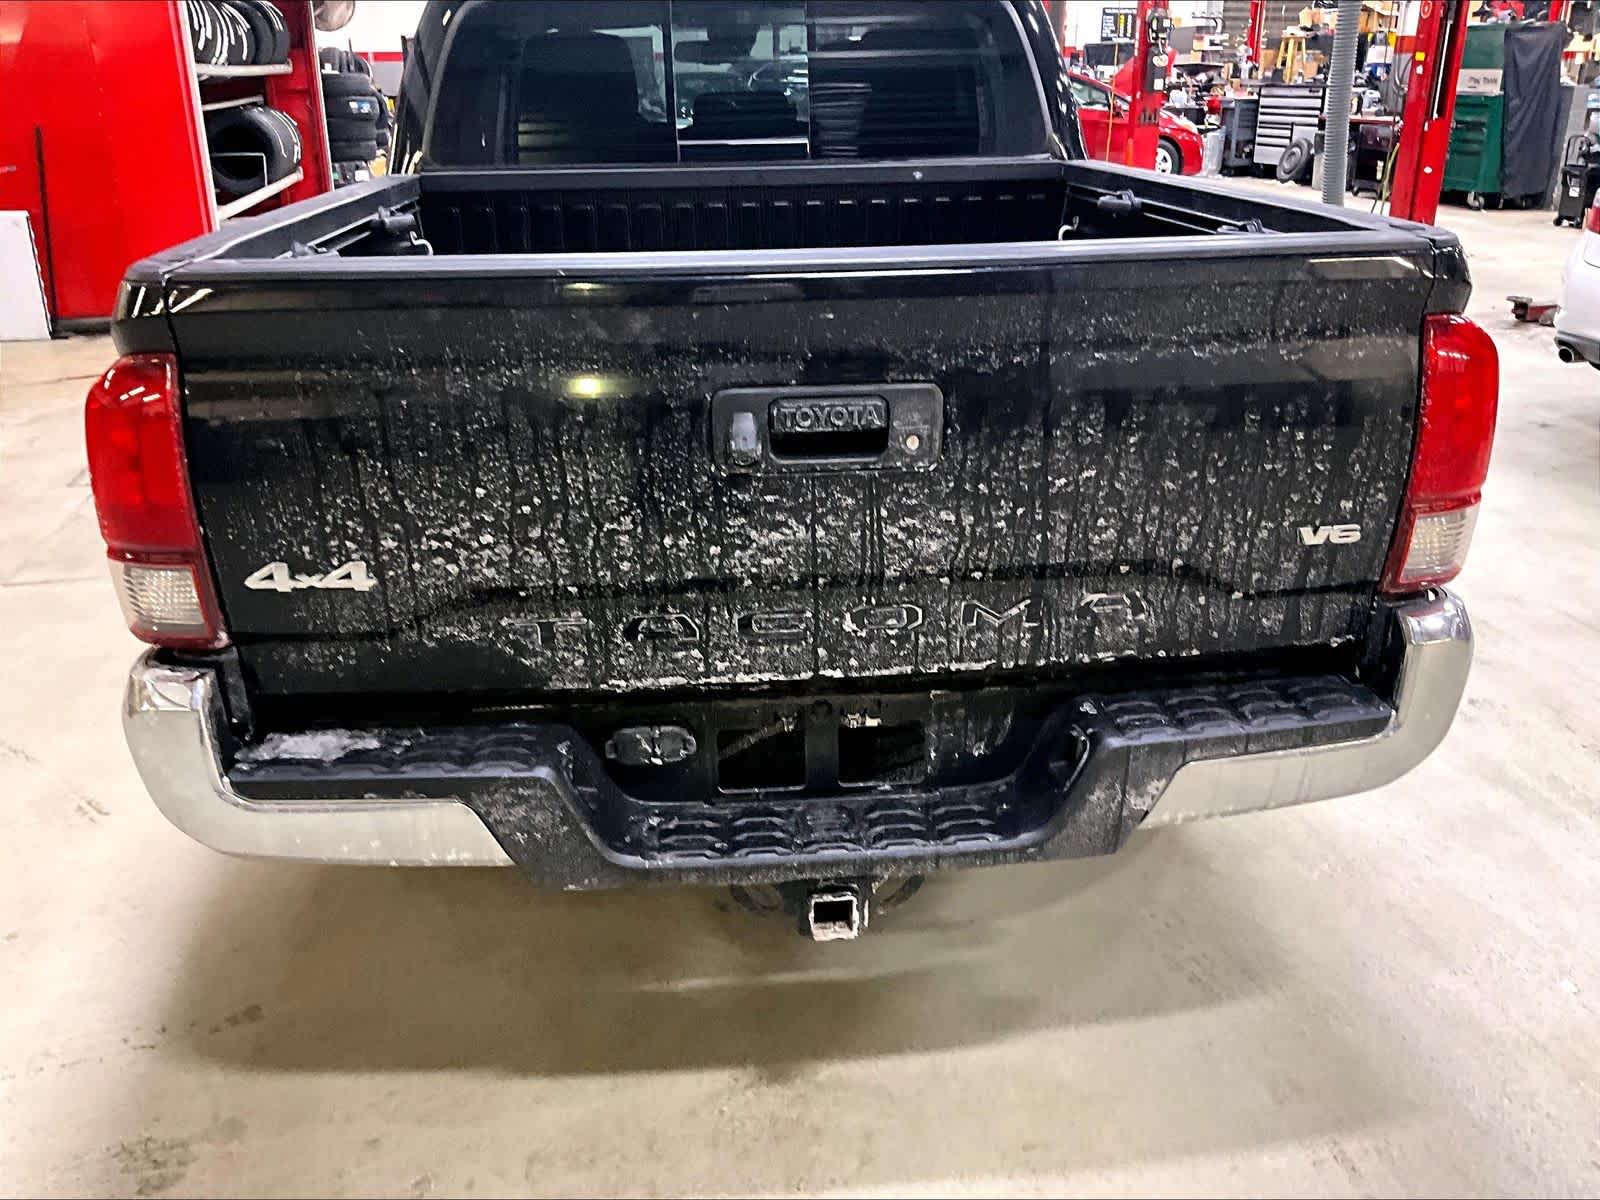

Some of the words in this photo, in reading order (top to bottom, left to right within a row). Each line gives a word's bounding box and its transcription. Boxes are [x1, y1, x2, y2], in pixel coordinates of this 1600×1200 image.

[781, 405, 883, 427] TOYOTA
[1298, 523, 1362, 546] V6
[244, 561, 377, 592] 4x4
[500, 591, 1150, 647] TACOMA
